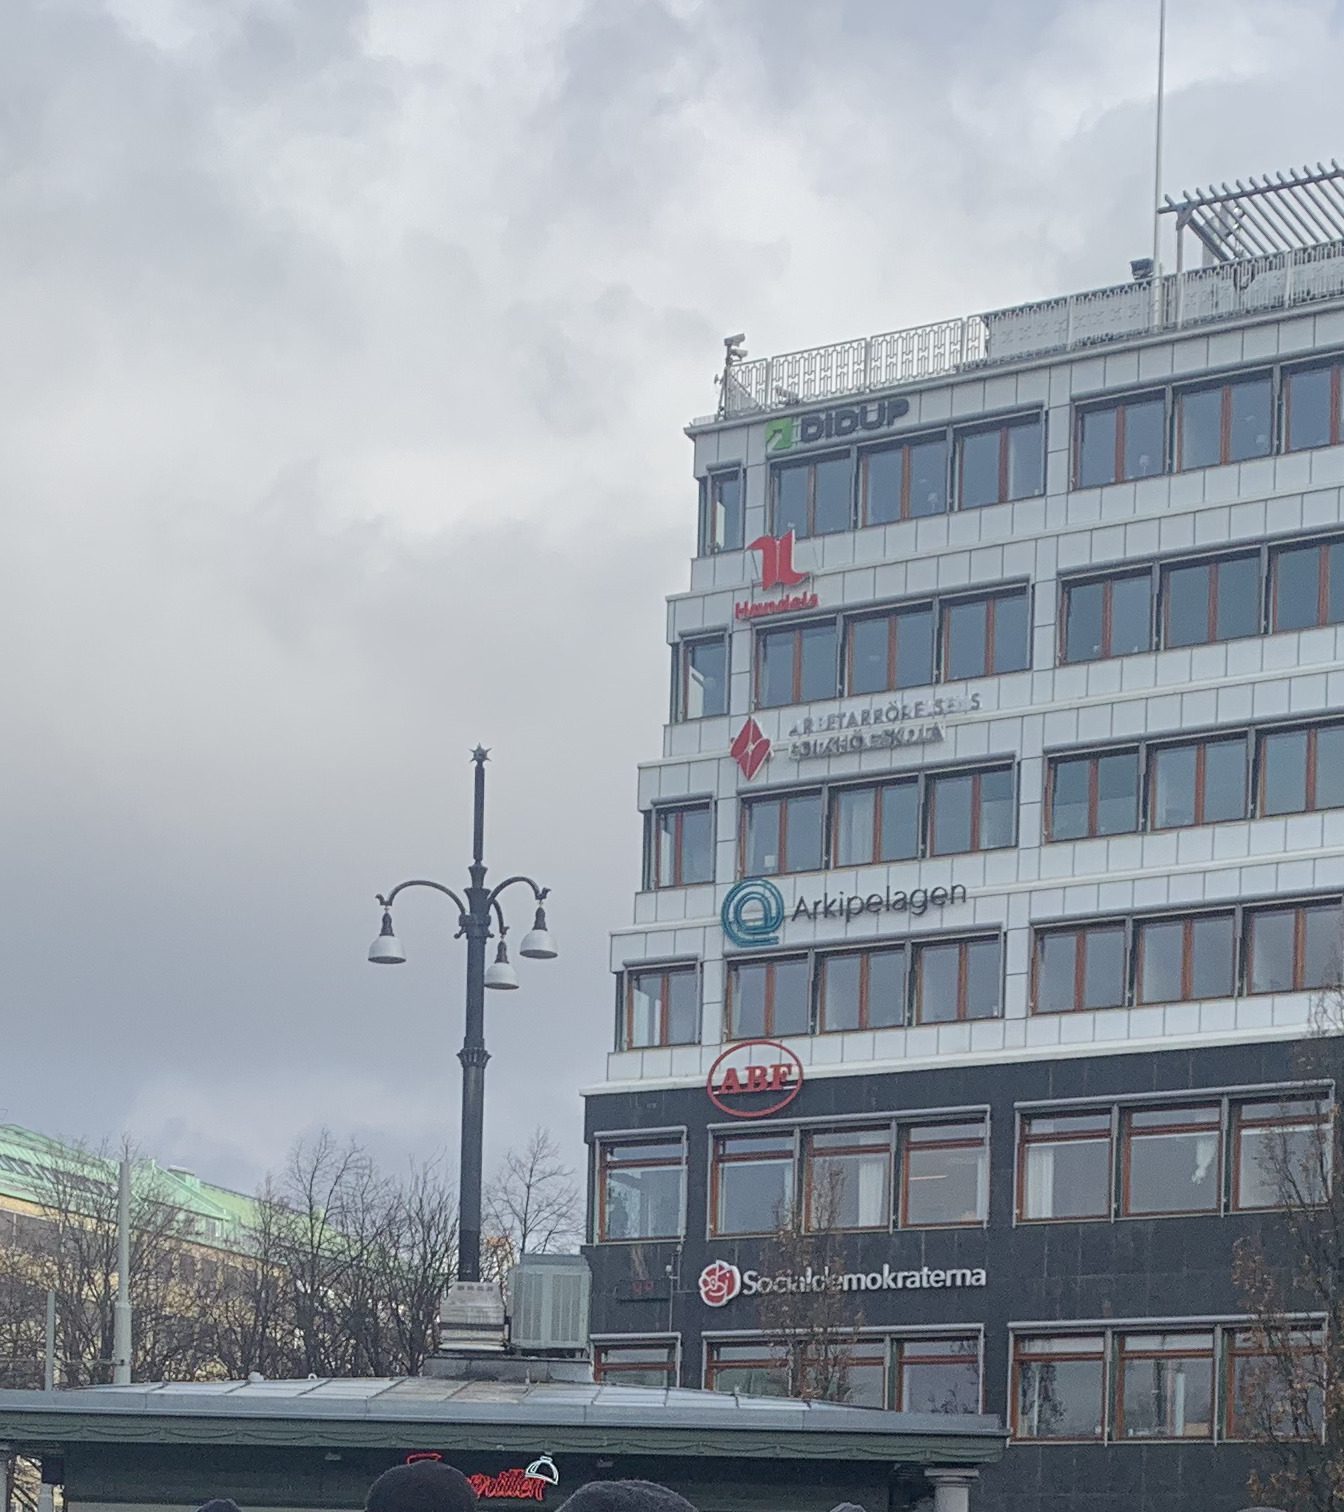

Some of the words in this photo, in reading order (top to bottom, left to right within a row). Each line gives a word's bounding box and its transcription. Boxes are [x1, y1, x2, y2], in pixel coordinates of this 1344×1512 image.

[791, 884, 966, 923] Arkipelagen
[718, 1063, 793, 1095] ABF
[742, 1263, 987, 1295] Socialdemokraterna
